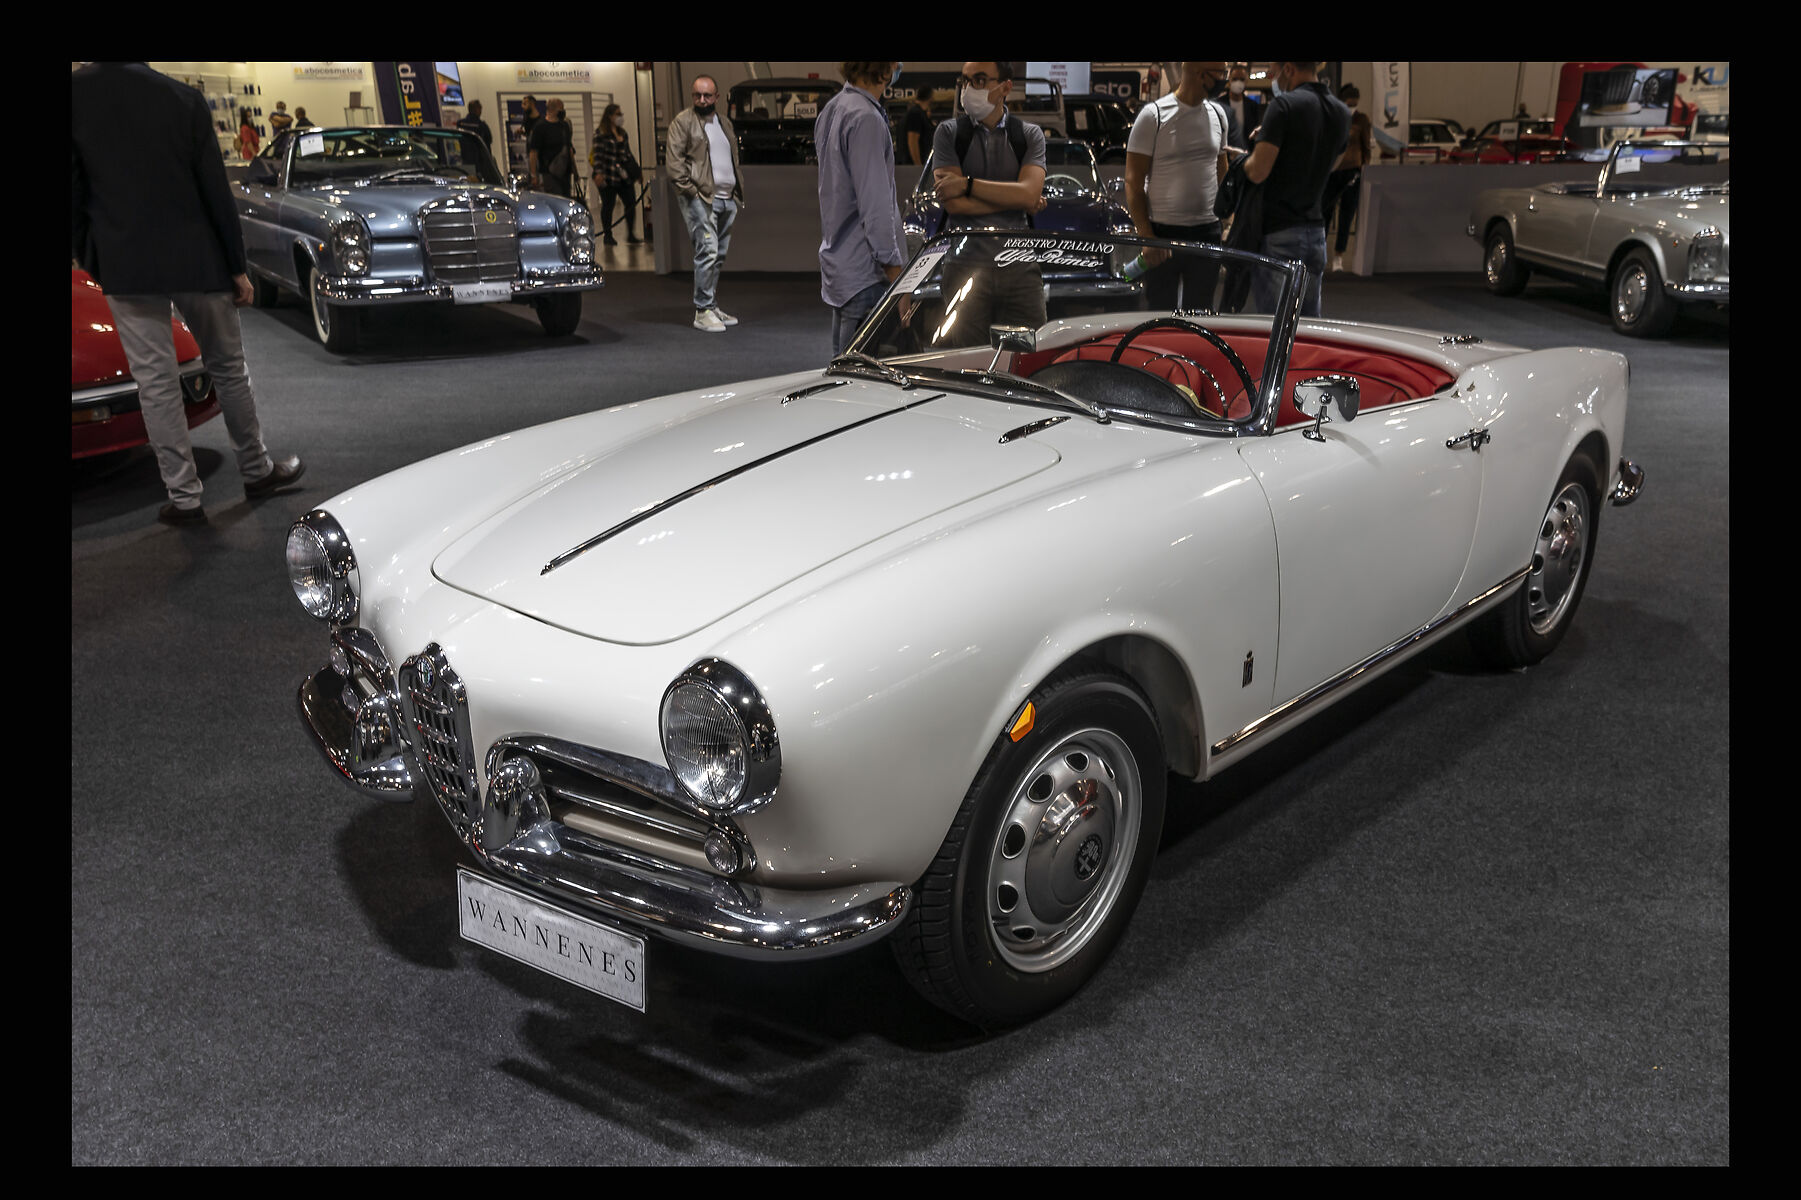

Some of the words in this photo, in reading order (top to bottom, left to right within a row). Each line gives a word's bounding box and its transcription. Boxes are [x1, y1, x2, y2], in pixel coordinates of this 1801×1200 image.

[1003, 238, 1057, 249] REGISTRO
[1057, 240, 1115, 254] ITALIANO
[994, 248, 1037, 267] Alfa
[1037, 249, 1104, 267] Romeo
[467, 896, 636, 983] WANNENES
